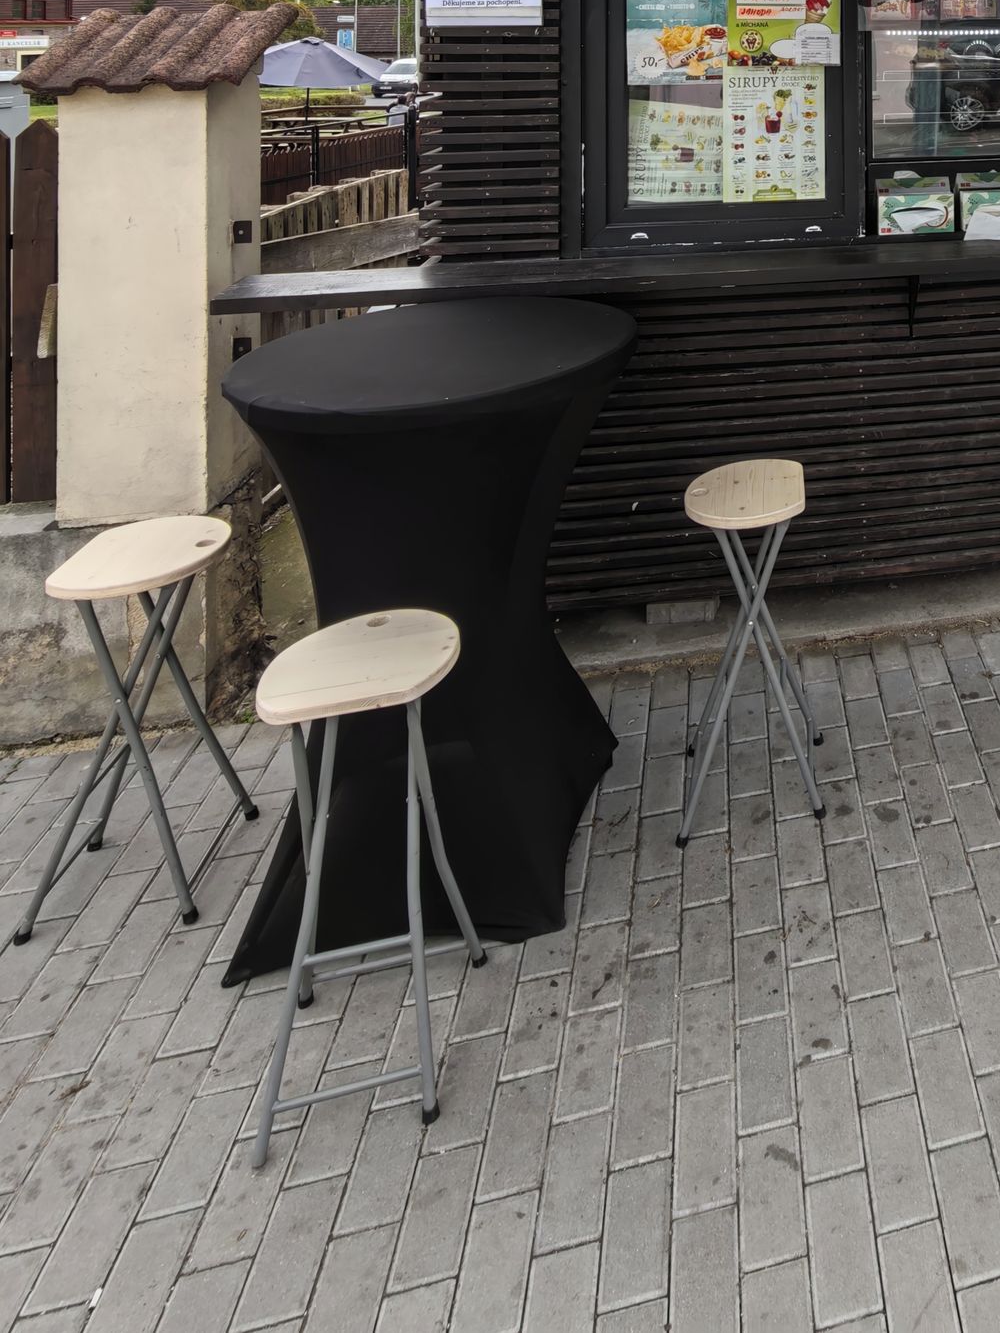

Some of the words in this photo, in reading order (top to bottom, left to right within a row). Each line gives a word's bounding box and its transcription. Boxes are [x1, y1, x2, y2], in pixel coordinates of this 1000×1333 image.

[442, 0, 476, 8] Děkujeme
[729, 77, 779, 88] SIRUPY
[633, 147, 647, 195] SIRUPY
